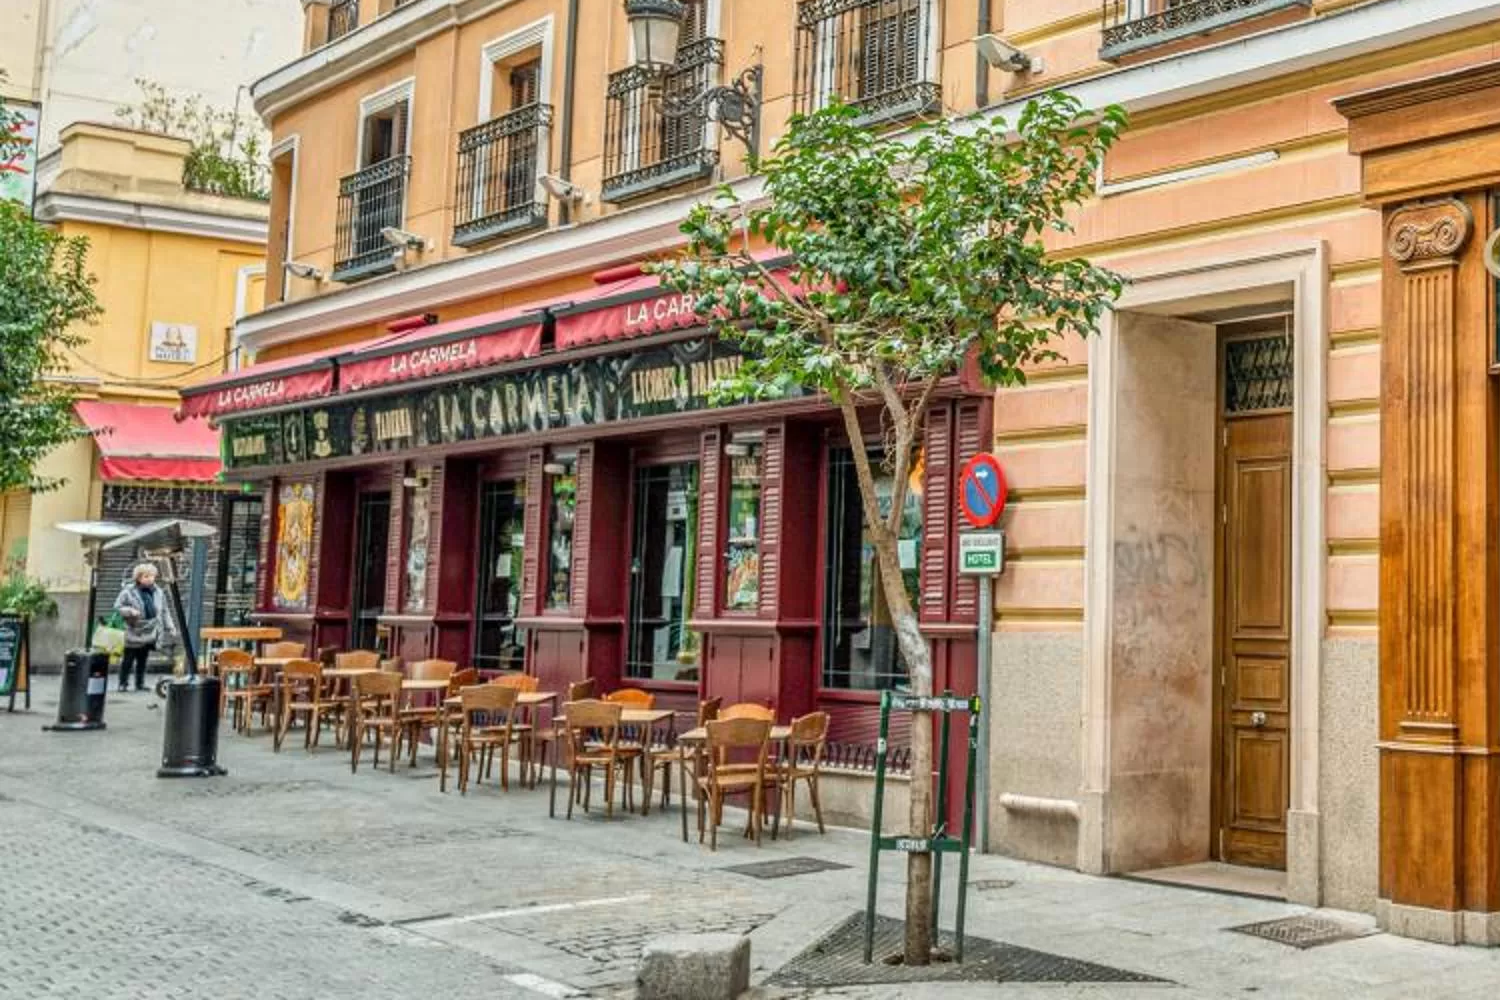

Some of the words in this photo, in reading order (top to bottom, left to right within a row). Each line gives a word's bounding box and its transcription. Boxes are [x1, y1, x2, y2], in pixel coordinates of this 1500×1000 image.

[626, 304, 649, 325] LA
[389, 354, 406, 373] LA
[409, 342, 477, 371] CARMELA
[218, 389, 231, 406] LA
[233, 379, 285, 403] CARMELA
[438, 394, 465, 434] LA
[471, 373, 593, 432] CARMELA
[967, 553, 993, 565] HOTEL
